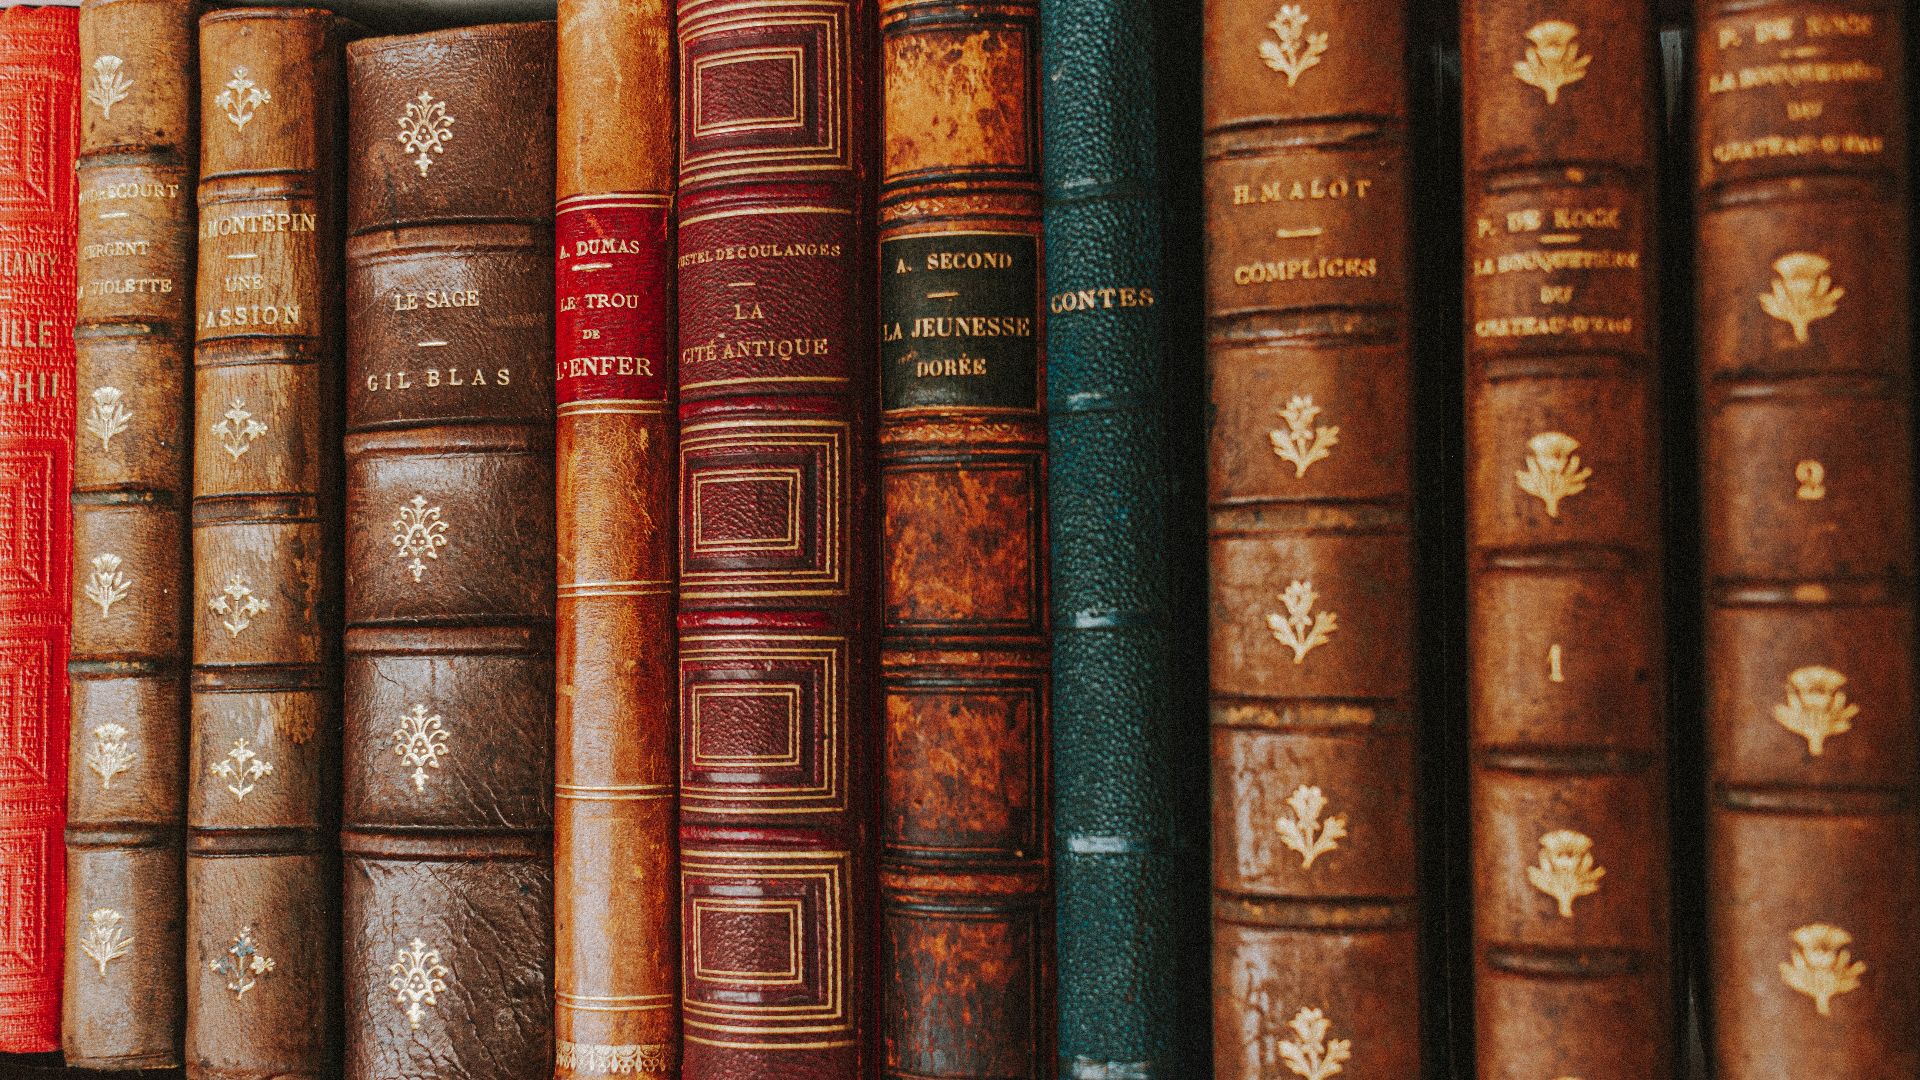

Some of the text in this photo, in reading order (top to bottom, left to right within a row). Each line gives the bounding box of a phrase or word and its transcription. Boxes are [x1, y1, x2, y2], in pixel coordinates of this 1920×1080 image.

[1261, 179, 1373, 203] MALOT
[576, 238, 640, 257] DUMAS
[737, 243, 842, 260] COULANGES
[927, 252, 1013, 271] SECOND
[225, 272, 265, 293] UNE
[394, 290, 480, 312] LE SAGE
[584, 293, 640, 309] TROU
[734, 303, 765, 321] LA
[1051, 286, 1155, 315] CONTES
[582, 329, 601, 340] DE
[884, 316, 1031, 342] LA JEUNESSE
[721, 338, 828, 361] ANTIQUE
[557, 355, 654, 381] L'ENFER
[917, 352, 987, 378] DORÉE
[367, 368, 512, 392] GIL BLAS
[1795, 459, 1825, 500] 2
[1548, 643, 1565, 682] 1
